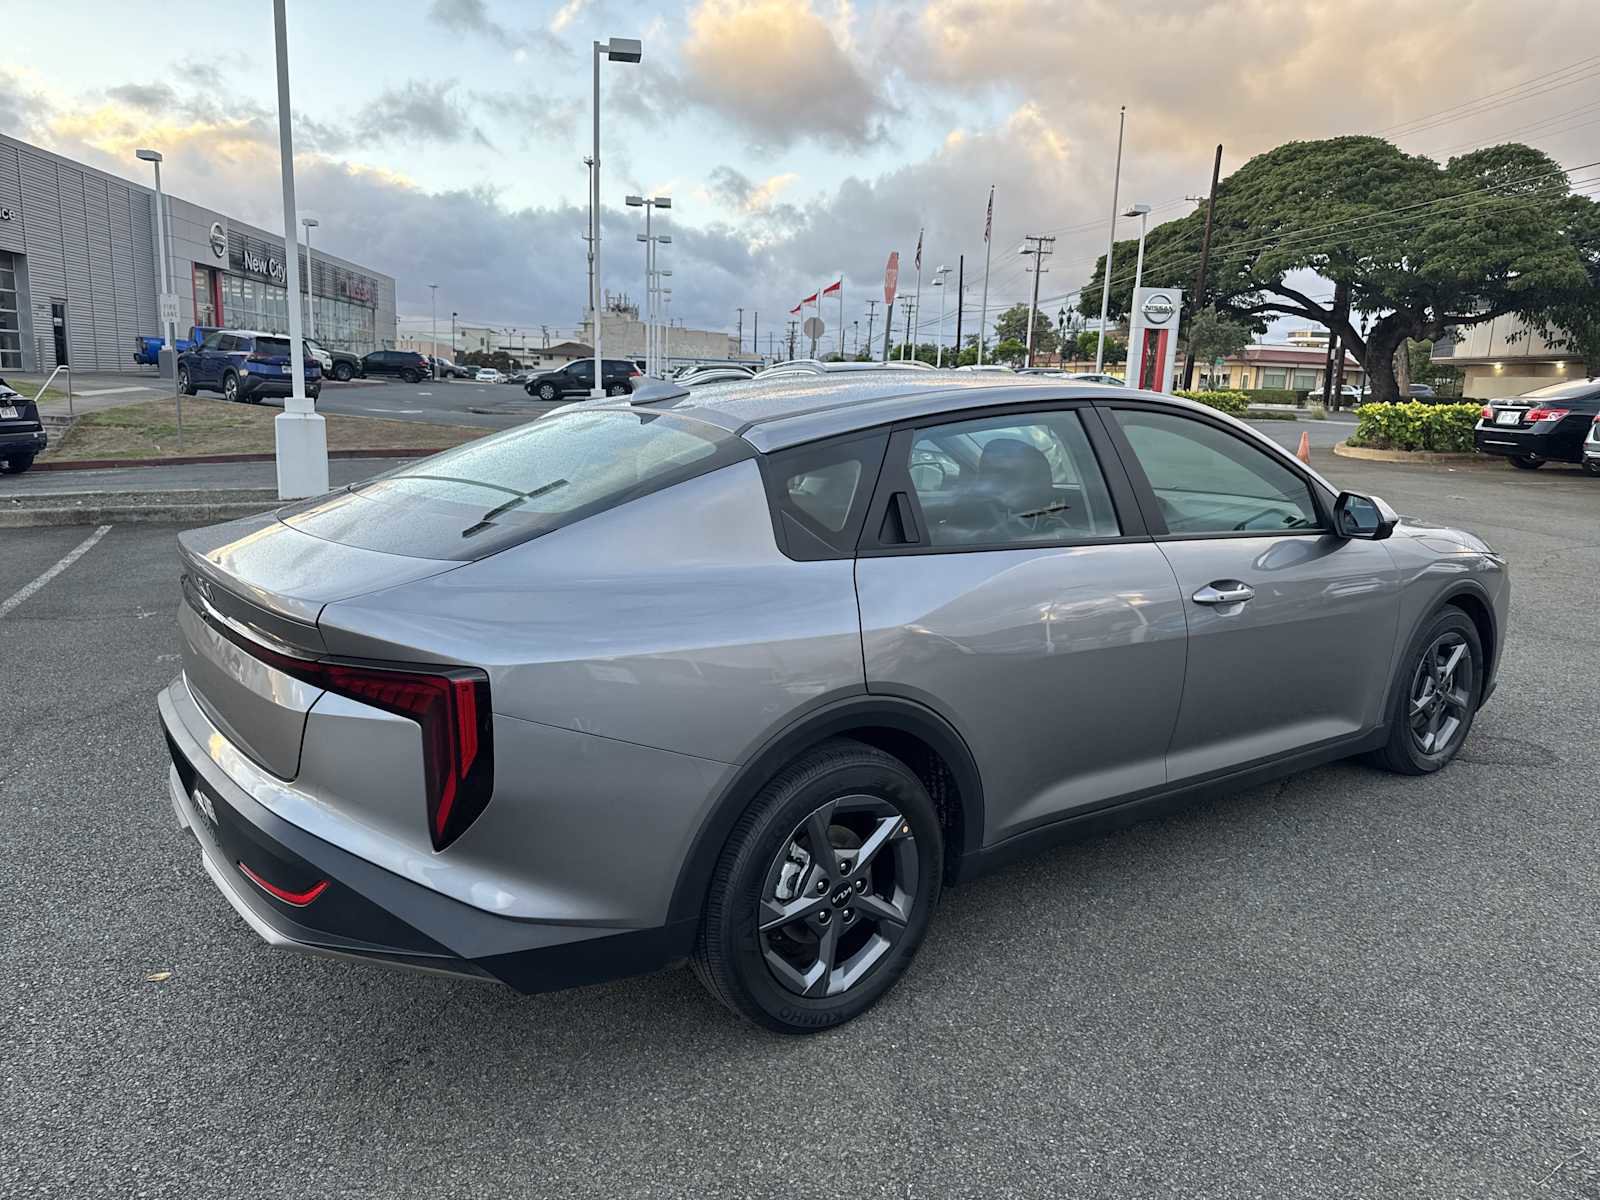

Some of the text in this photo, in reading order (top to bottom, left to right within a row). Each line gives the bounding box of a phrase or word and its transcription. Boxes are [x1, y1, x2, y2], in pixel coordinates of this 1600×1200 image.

[244, 250, 286, 282] New City
[1144, 303, 1174, 312] NISSAN
[780, 1006, 846, 1025] KUMHO
